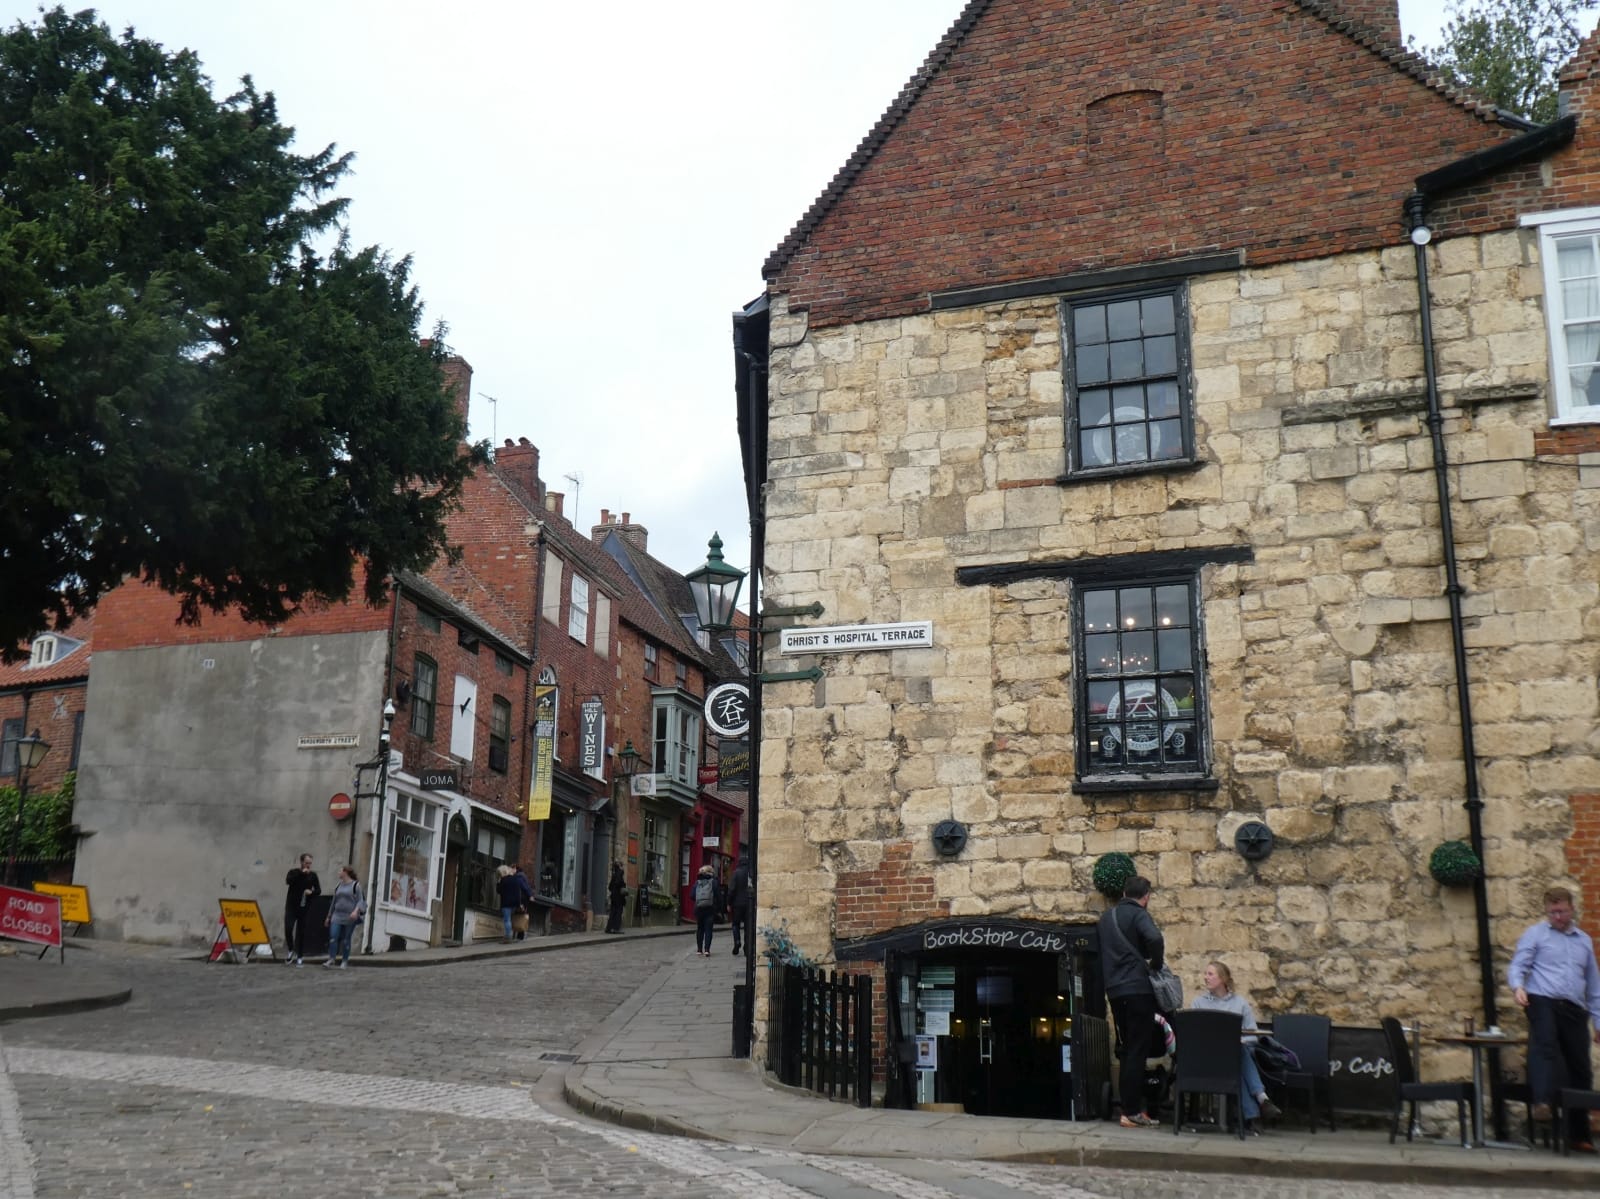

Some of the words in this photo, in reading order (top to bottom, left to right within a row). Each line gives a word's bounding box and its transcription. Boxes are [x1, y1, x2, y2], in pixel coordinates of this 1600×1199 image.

[834, 632, 878, 644] HOSPITAL
[881, 629, 926, 641] TERRACE
[583, 713, 598, 766] WINES
[423, 775, 454, 785] JOMA
[8, 896, 44, 914] ROAD
[225, 907, 257, 918] Diversion
[2, 915, 52, 936] CLOSED
[1349, 1057, 1395, 1079] Cafe
